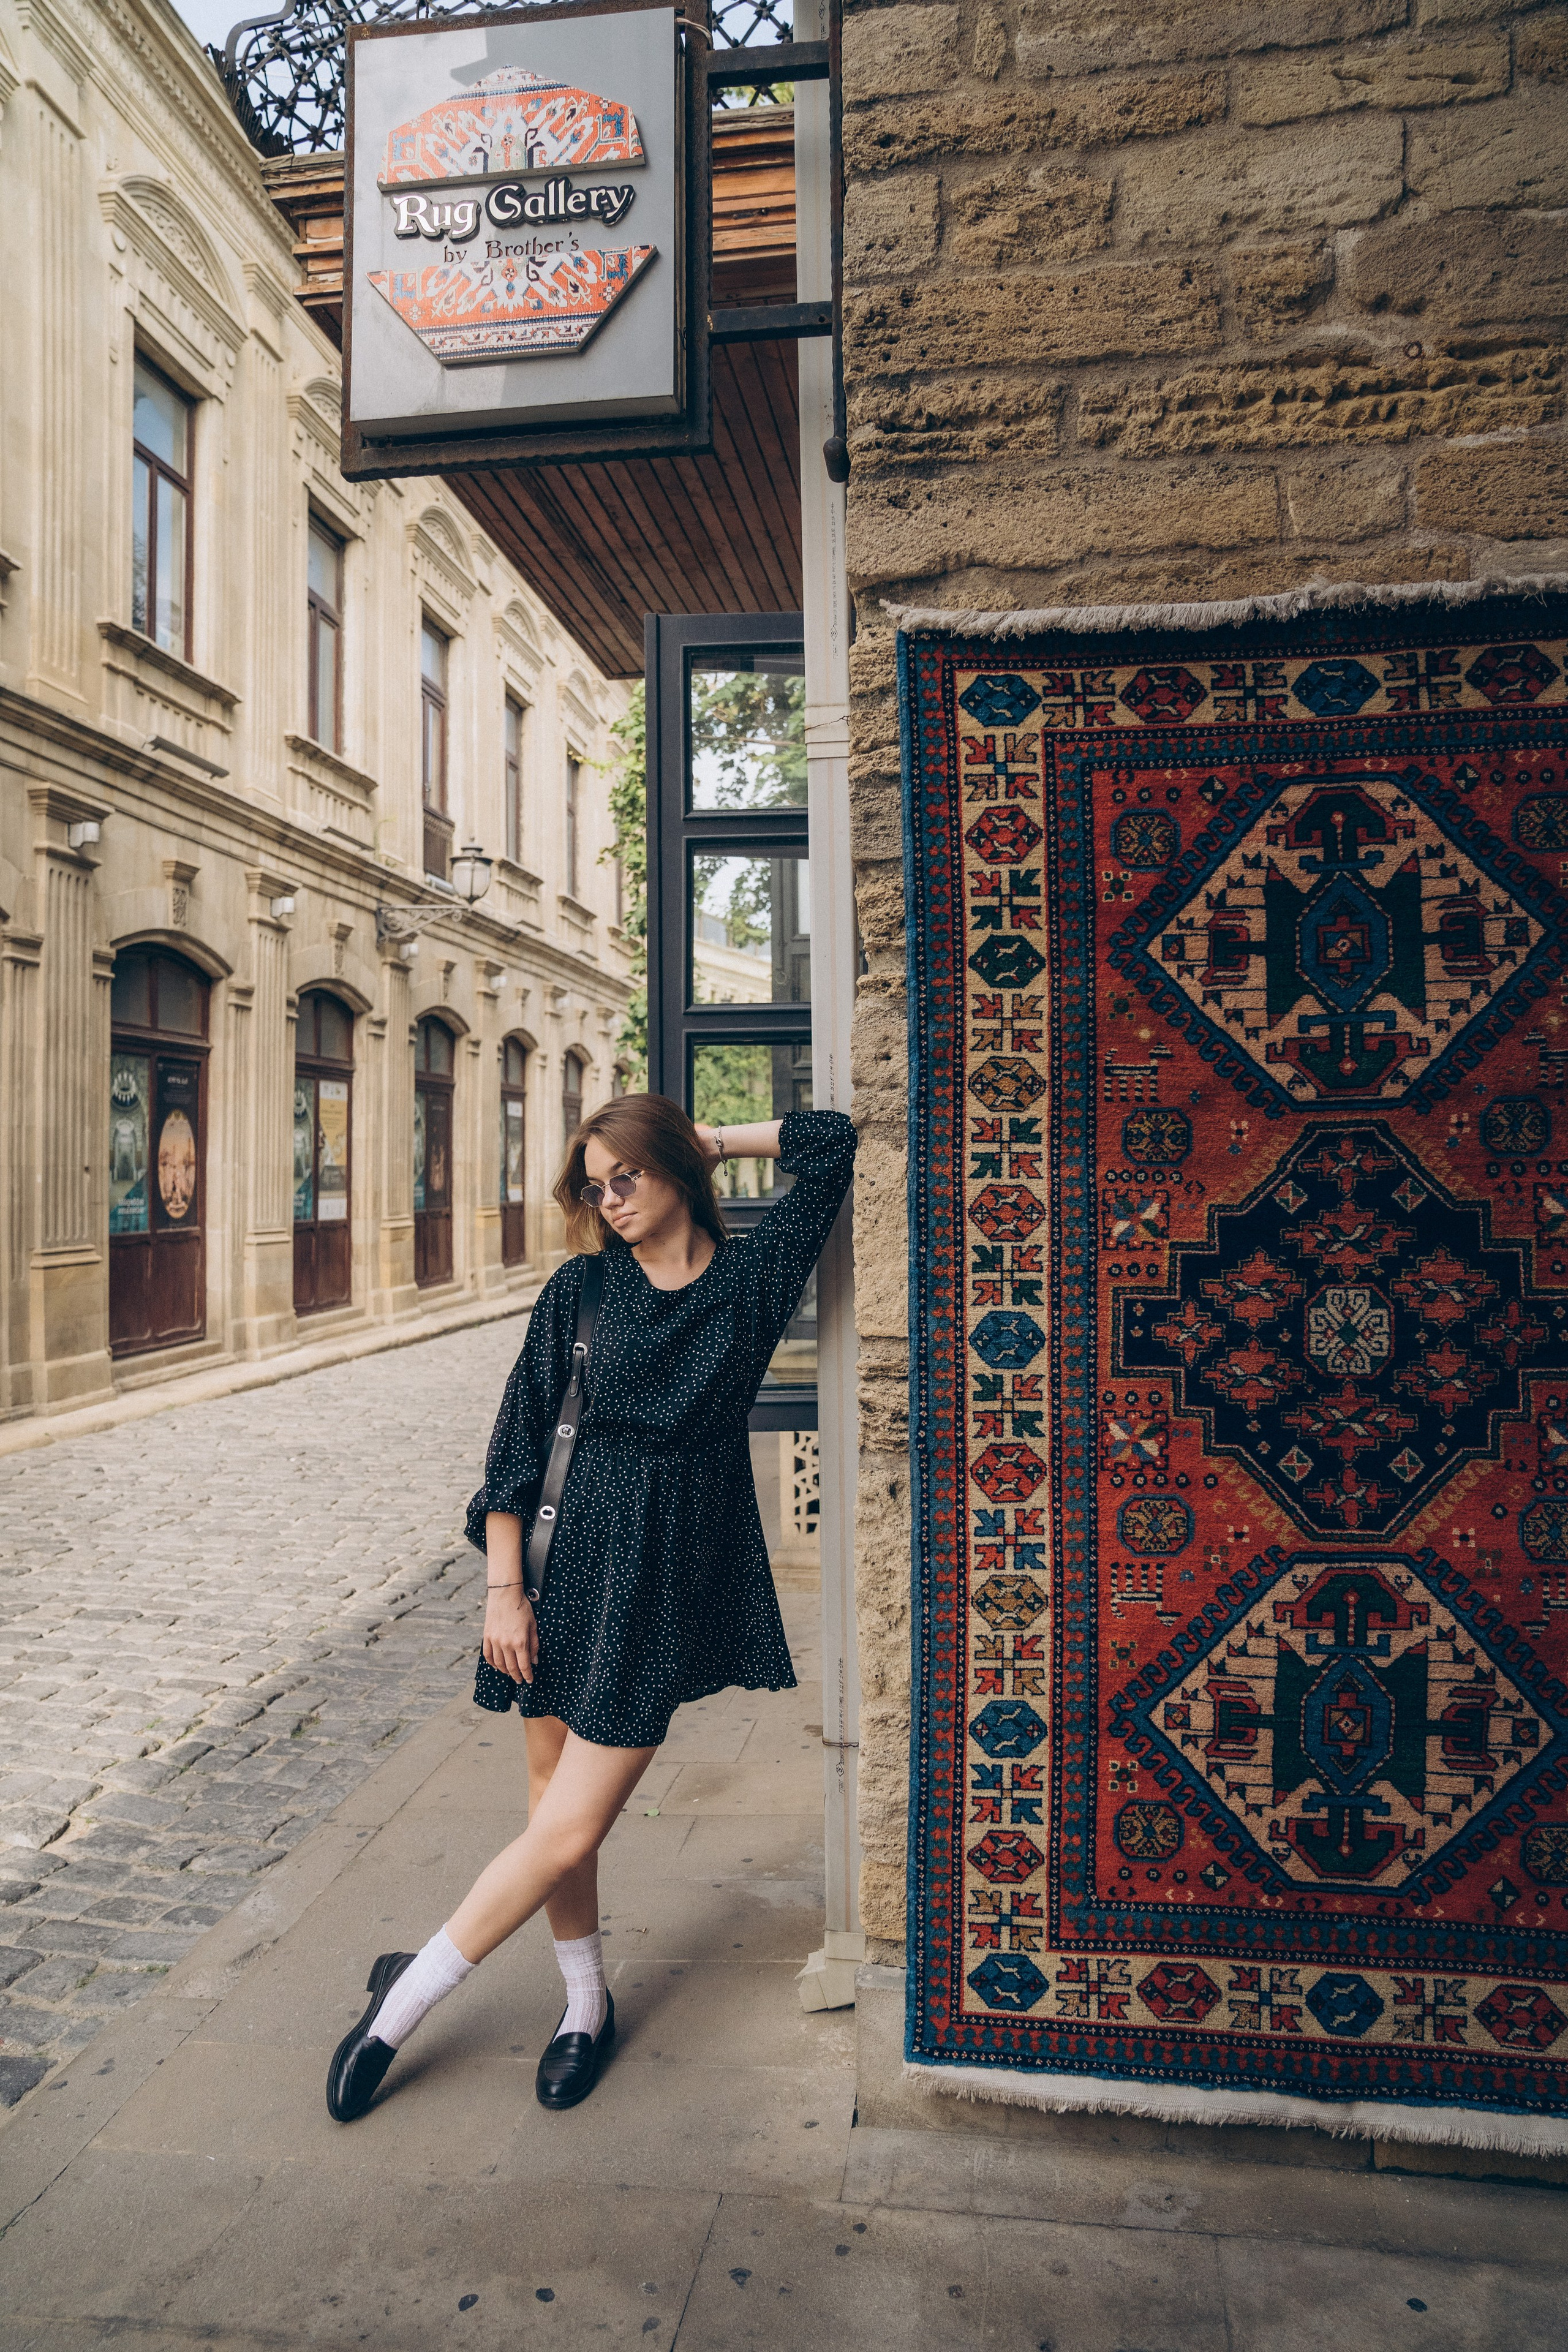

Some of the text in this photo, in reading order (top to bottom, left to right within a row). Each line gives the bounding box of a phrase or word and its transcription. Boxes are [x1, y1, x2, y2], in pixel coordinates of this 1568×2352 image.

[392, 178, 631, 235] Rug Gallery
[443, 232, 579, 263] by Brother's
